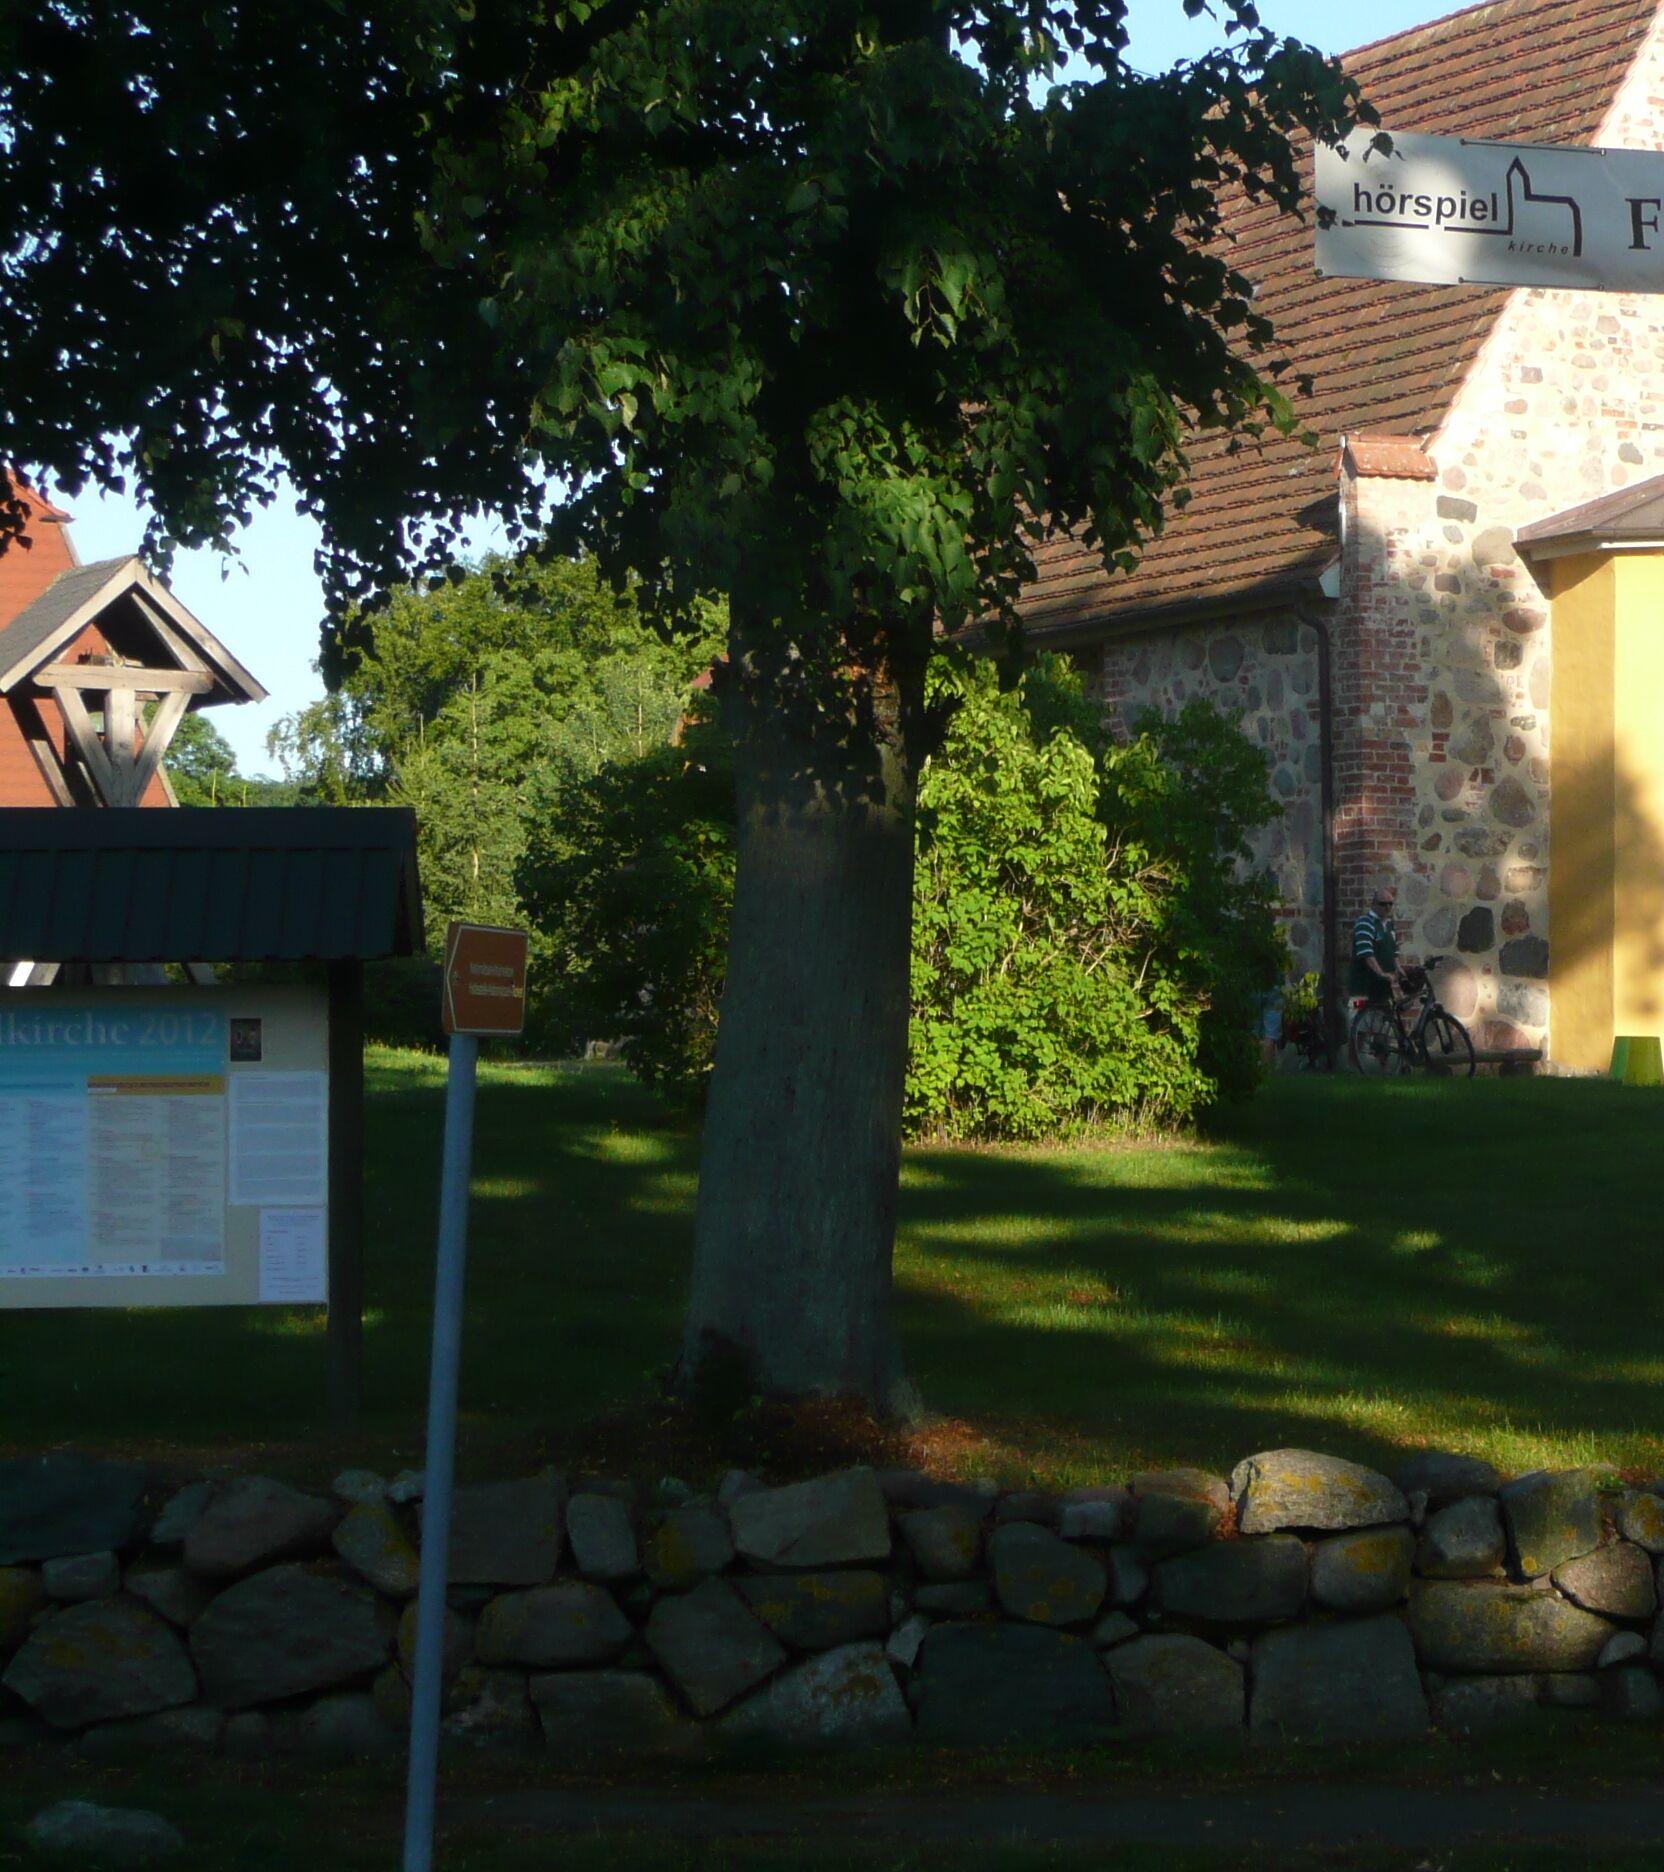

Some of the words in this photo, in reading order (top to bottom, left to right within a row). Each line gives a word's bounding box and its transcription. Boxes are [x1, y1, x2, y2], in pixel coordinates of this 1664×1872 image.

[1354, 182, 1498, 226] hörspiel
[1508, 240, 1568, 255] kirche
[139, 1014, 219, 1045] 2012
